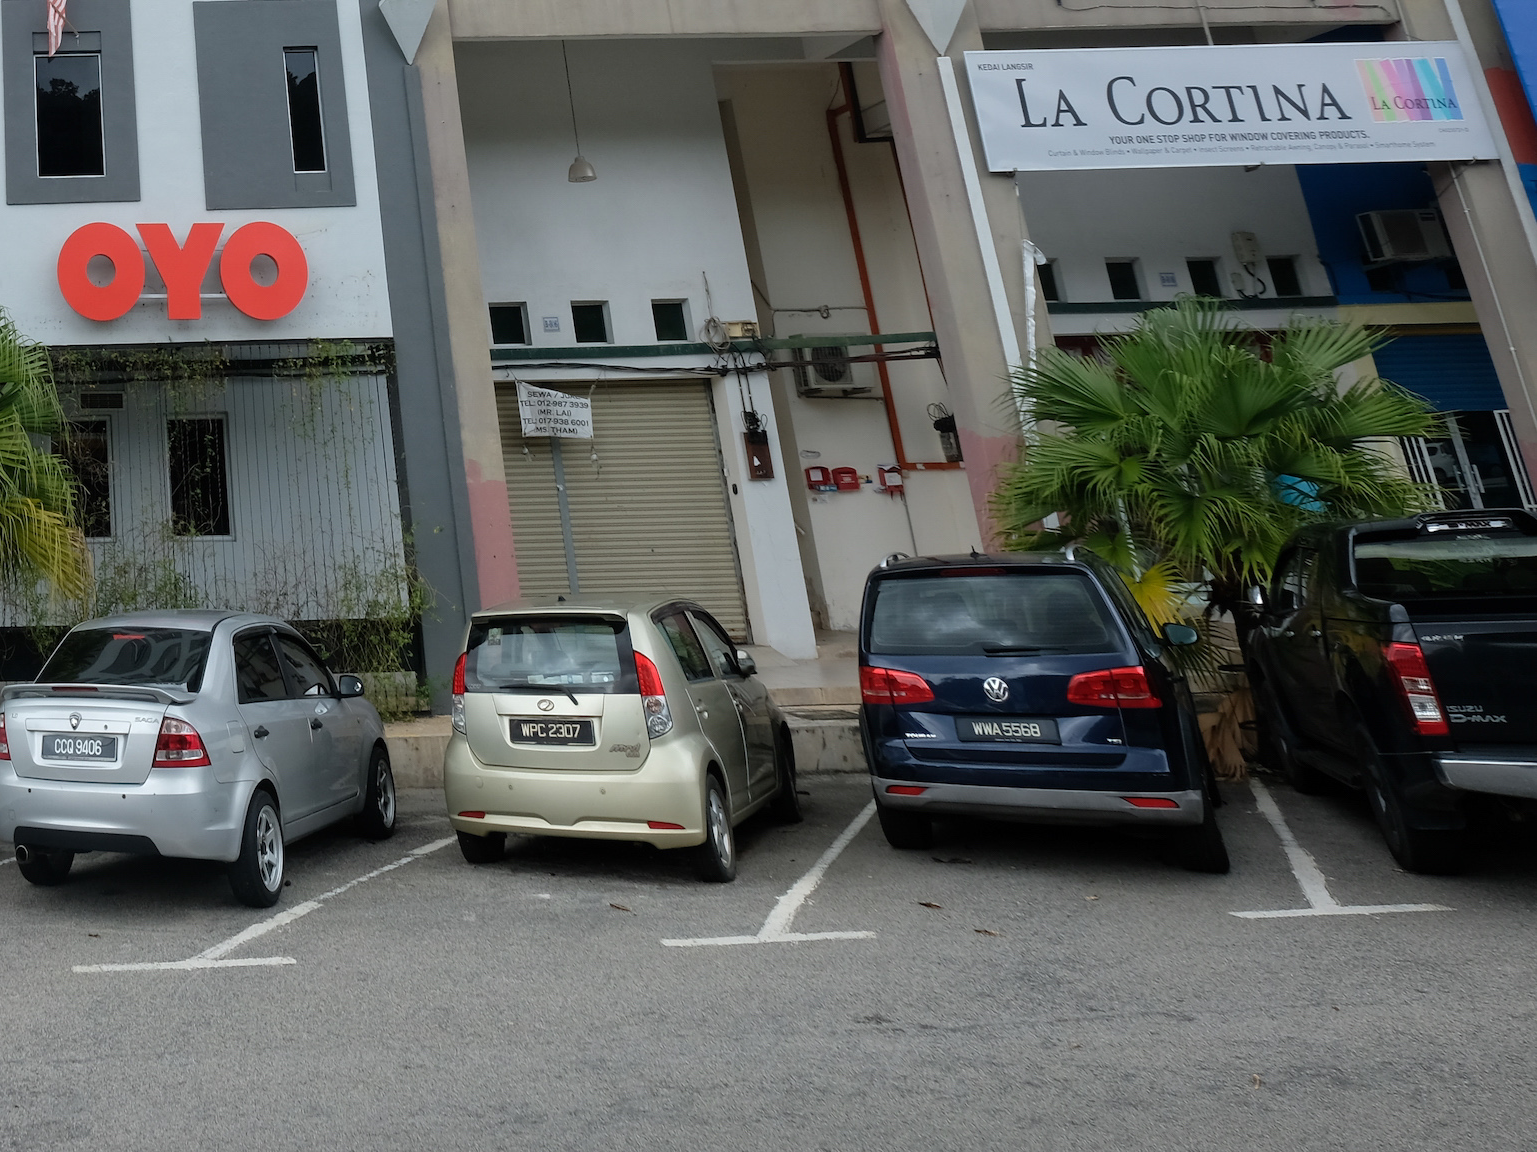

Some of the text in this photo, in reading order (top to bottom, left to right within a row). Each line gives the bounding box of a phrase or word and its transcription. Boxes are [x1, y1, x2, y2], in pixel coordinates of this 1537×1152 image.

[1001, 63, 1034, 71] LANGSIR
[1109, 130, 1370, 145] YOUR ONE STOP SHOP FOR WINDOW COVERING PRODUCTS.
[56, 221, 309, 321] OYO
[537, 400, 568, 408] 012-987
[1446, 705, 1484, 713] ISUZU
[134, 716, 160, 724] SAGA
[1449, 714, 1508, 723] D-MAX
[521, 723, 580, 738] WPC 2307
[54, 738, 102, 755] CCQ 9406
